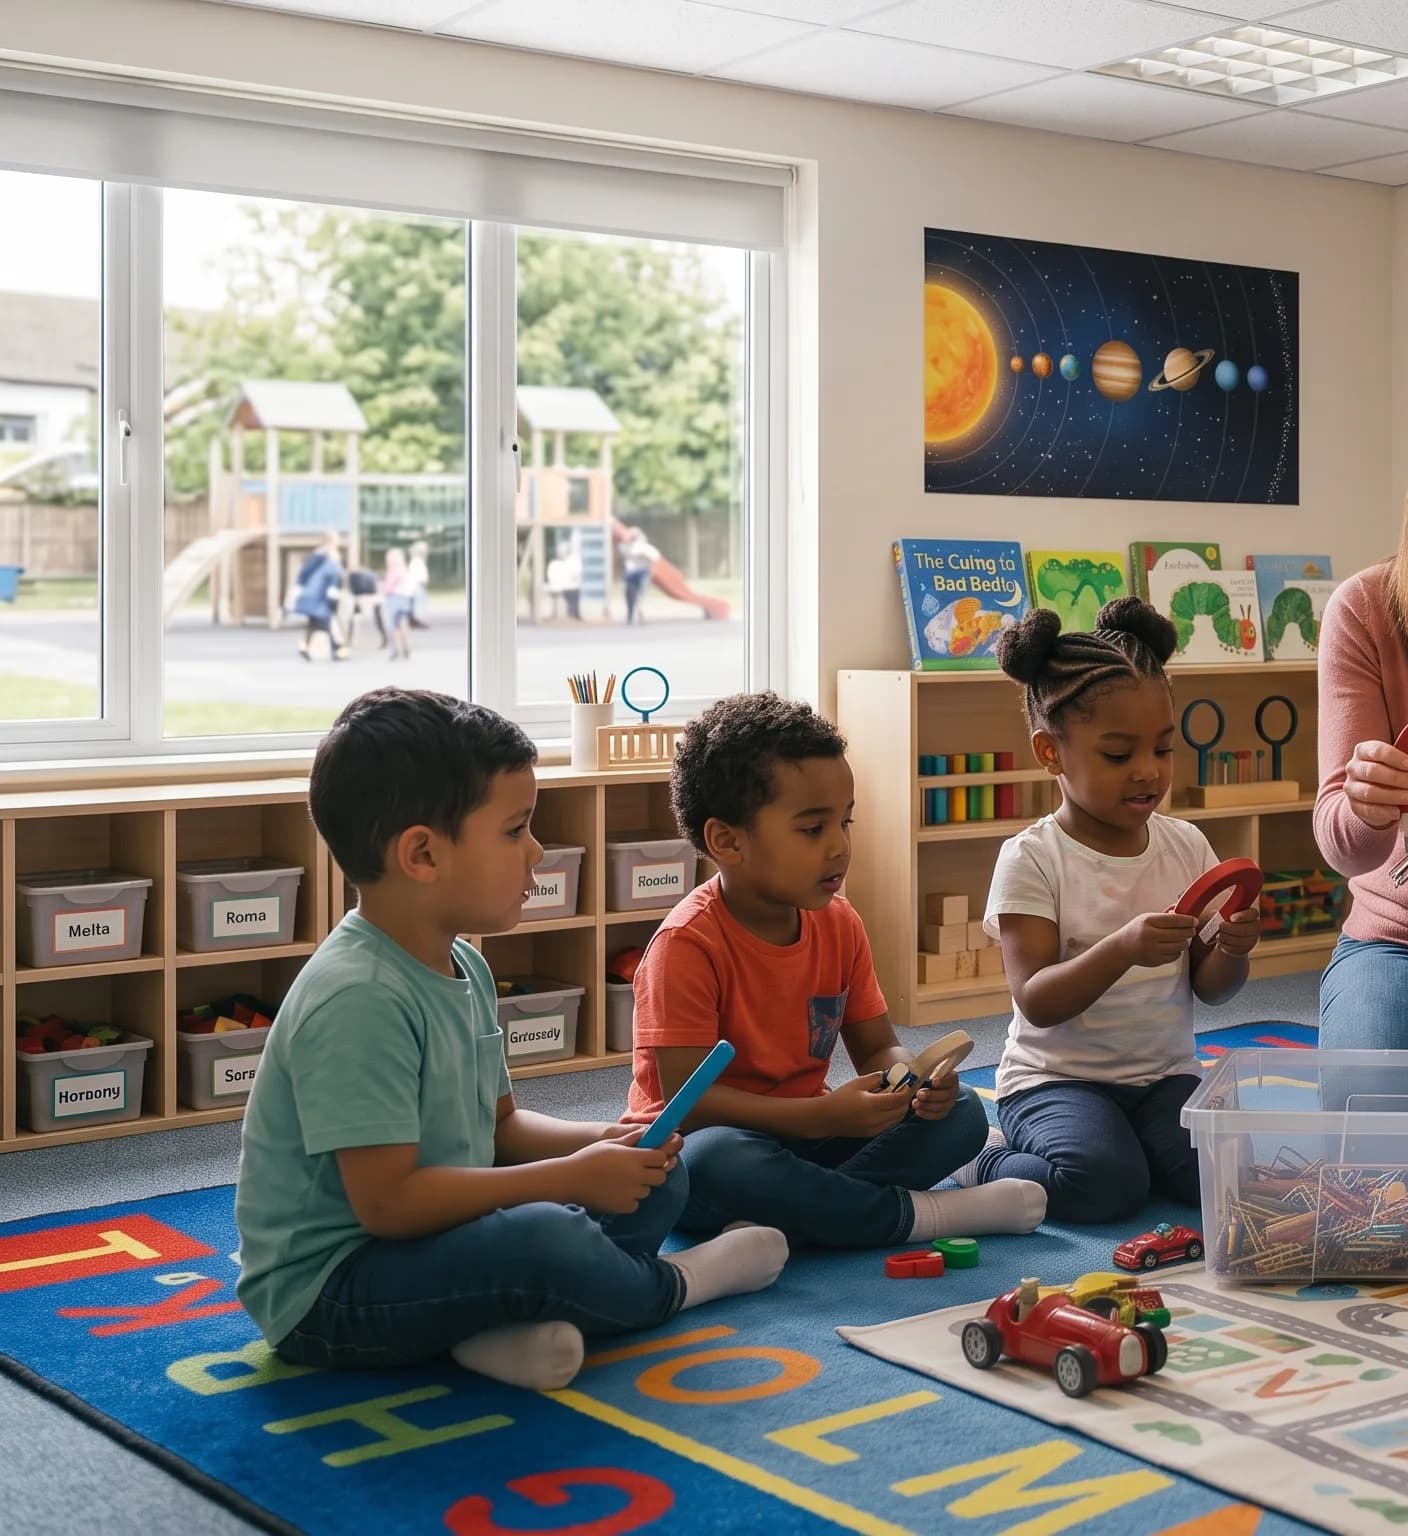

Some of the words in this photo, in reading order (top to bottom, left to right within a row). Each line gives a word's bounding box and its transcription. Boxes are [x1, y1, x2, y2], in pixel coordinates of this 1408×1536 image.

[914, 553, 944, 569] The
[933, 575, 967, 592] Bad
[226, 910, 267, 925] Roma
[68, 923, 110, 938] Melta
